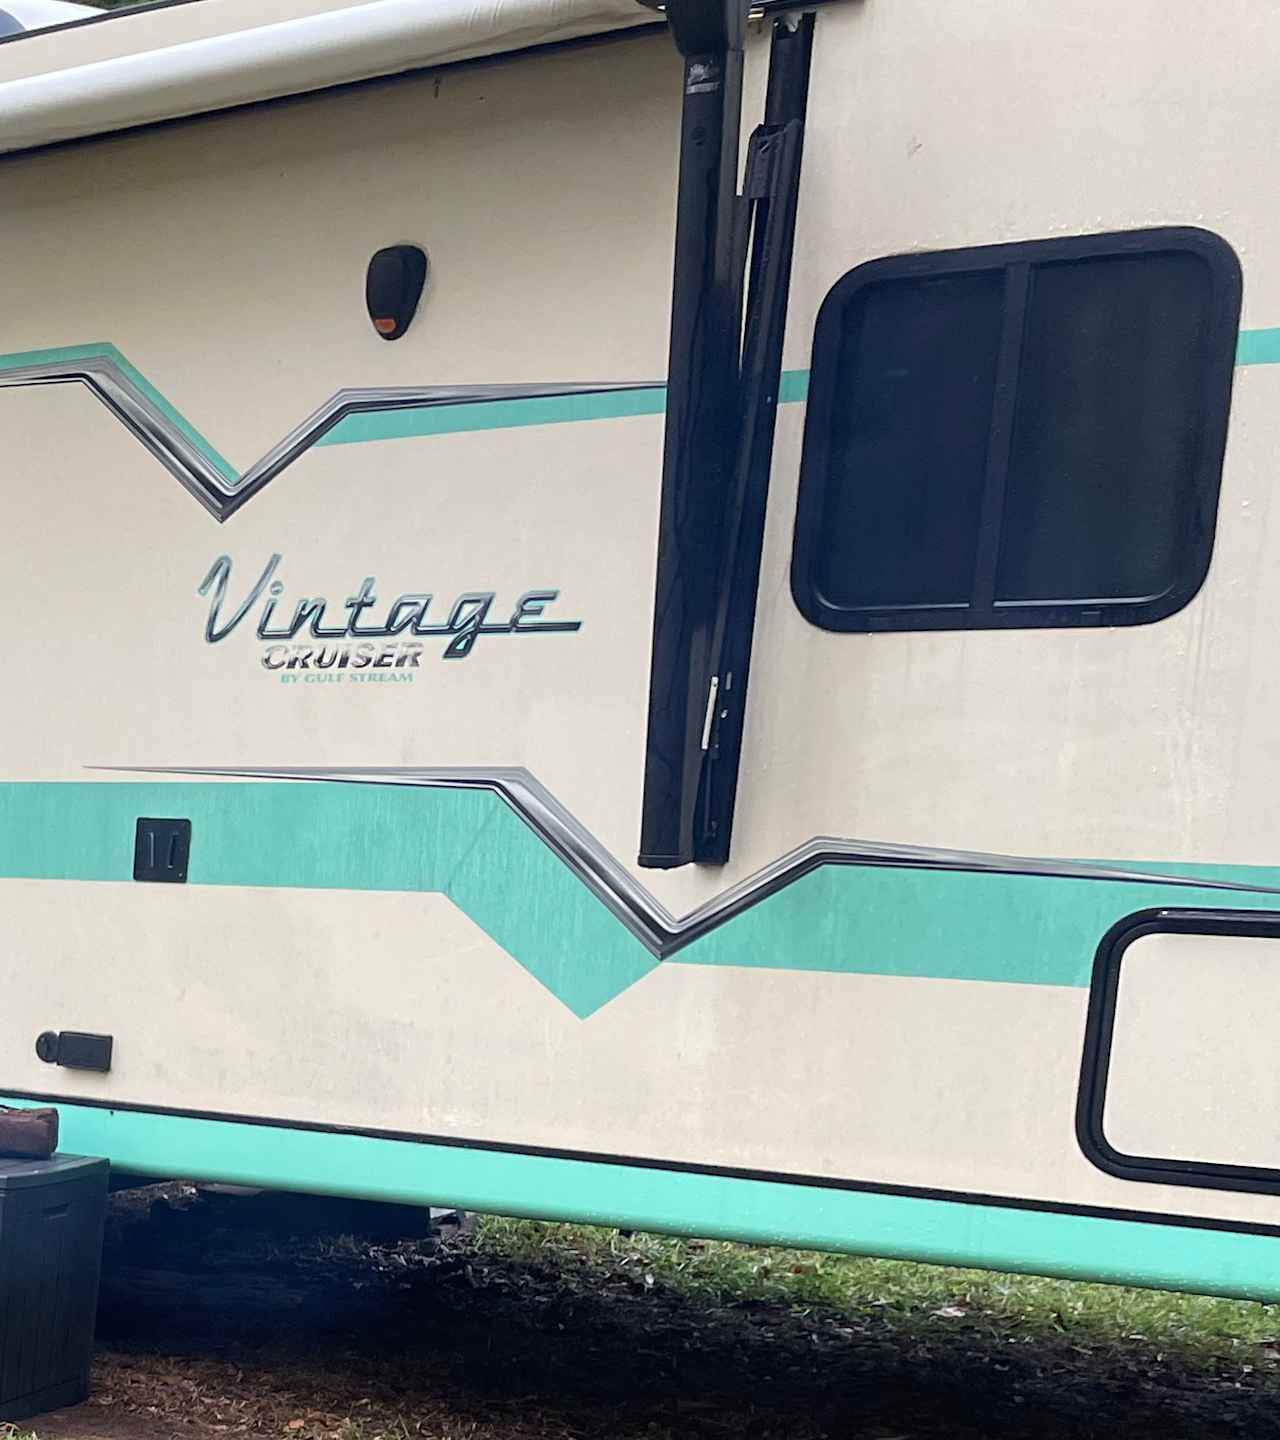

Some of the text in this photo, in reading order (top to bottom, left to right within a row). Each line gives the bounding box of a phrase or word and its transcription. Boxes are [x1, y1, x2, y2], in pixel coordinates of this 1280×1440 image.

[198, 553, 582, 659] Vintage
[261, 641, 423, 670] CRUISER
[281, 673, 414, 684] BY GULF STREAM
